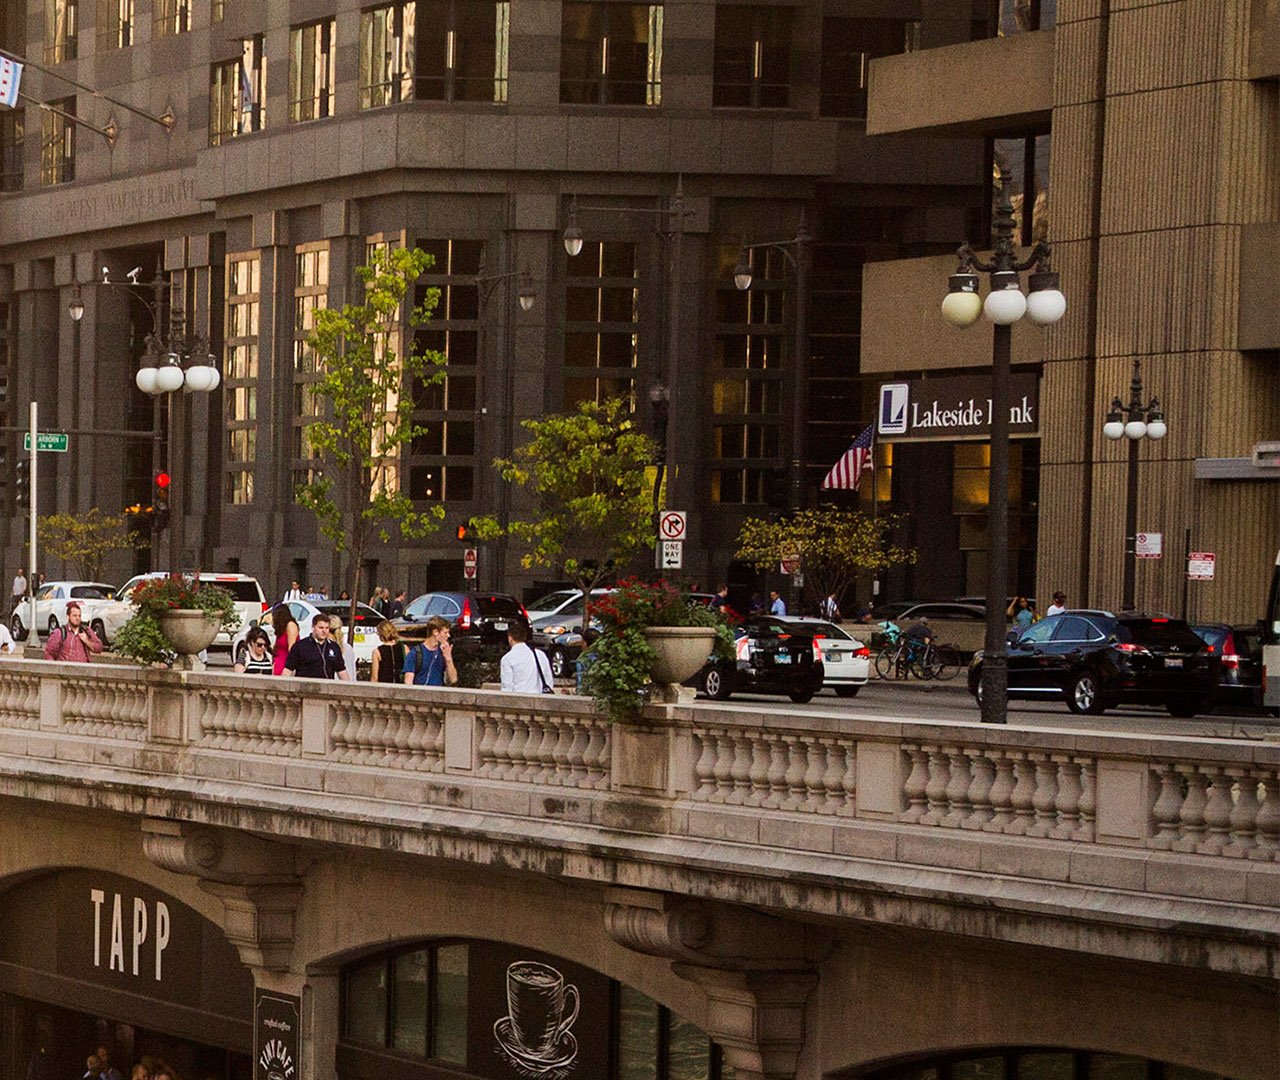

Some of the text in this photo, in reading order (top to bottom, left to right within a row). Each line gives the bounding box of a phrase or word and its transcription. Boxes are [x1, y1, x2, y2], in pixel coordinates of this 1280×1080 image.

[912, 396, 1033, 428] Lakeside nk
[91, 889, 171, 981] TAPP
[259, 1038, 276, 1071] TINY
